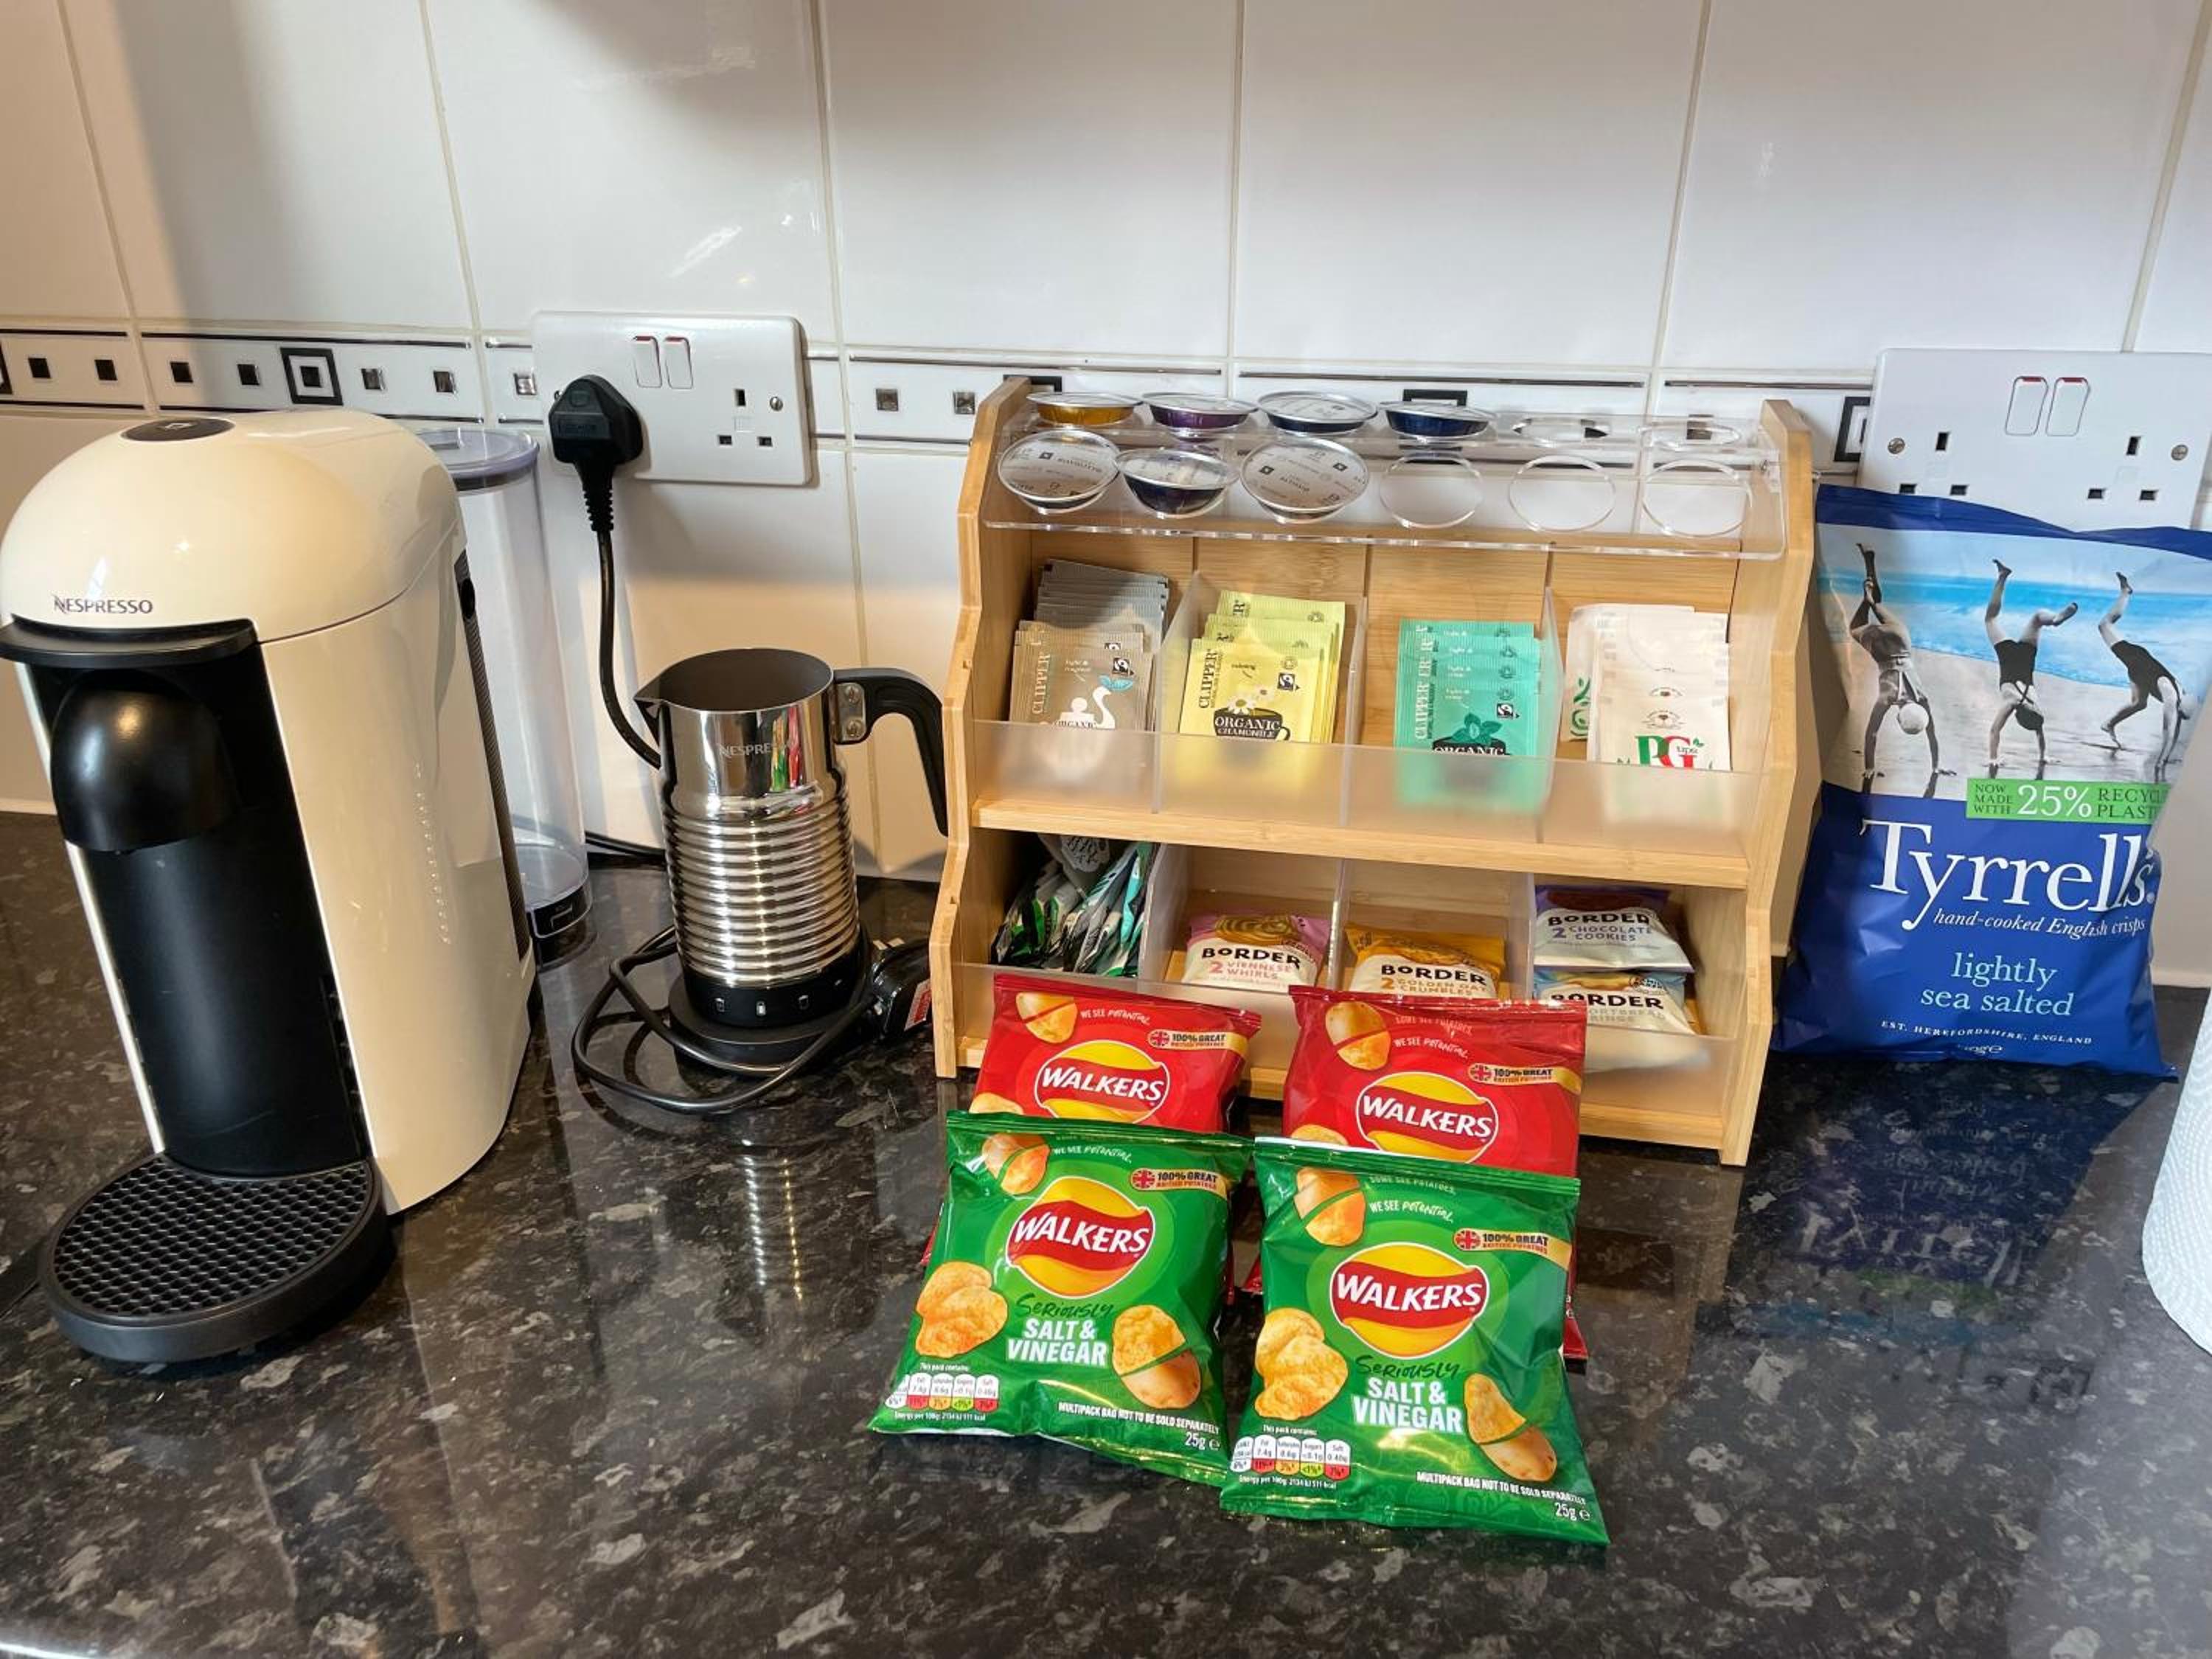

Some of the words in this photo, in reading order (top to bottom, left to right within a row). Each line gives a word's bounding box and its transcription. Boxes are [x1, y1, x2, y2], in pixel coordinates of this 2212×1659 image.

[54, 594, 153, 614] NESPRESSO
[1032, 654, 1050, 714] CLIPPER
[1199, 649, 1218, 709] CLIPPER
[1214, 715, 1281, 731] ORGANIC
[1415, 683, 1430, 740] CLIPPER
[1635, 734, 1697, 769] PG
[1974, 794, 2014, 804] MADE
[1975, 783, 2007, 795] NOW
[1973, 804, 2011, 815] WITH
[2017, 784, 2093, 818] 25%
[1551, 928, 1567, 939] 2
[1568, 925, 1652, 935] CHOCOLATE
[1933, 908, 2045, 933] hand-cooked
[2046, 917, 2109, 940] English
[2110, 916, 2146, 938] crisps
[1575, 933, 1637, 942] COOKIES
[1202, 947, 1301, 970] BORDER
[1209, 961, 1223, 974] 2
[1226, 961, 1292, 973] VIENNESE
[1226, 968, 1279, 981] WHIRLS
[1381, 964, 1488, 987] BORDER
[1381, 977, 1396, 990] 2
[1397, 978, 1455, 989] GOLDEN
[1950, 952, 2058, 992] lightly
[1400, 985, 1473, 996] CRUMBLES
[1920, 987, 1971, 1010] sea
[1980, 989, 2075, 1016] salted
[1172, 1033, 1197, 1043] 100%
[1198, 1033, 1226, 1043] GREAT
[1393, 1037, 1408, 1048] WE
[1408, 1036, 1422, 1046] SEE
[1881, 1020, 1908, 1032] EST.
[2032, 1033, 2093, 1046] ENGLAND
[1041, 1065, 1165, 1102] WALKERS
[1494, 1068, 1522, 1077] 100%
[1523, 1068, 1554, 1077] GREAT
[1362, 1095, 1494, 1138] WALKERS
[1157, 1172, 1186, 1181] 100%
[1186, 1172, 1218, 1183] GREAT
[1369, 1201, 1384, 1214] WE
[1383, 1200, 1400, 1211] SEE
[1013, 1211, 1152, 1254] WALKERS
[1482, 1233, 1514, 1243] 100%
[1515, 1234, 1549, 1246] GREAT
[1336, 1273, 1484, 1312] WALKERS
[1023, 1317, 1079, 1340] SALT
[1079, 1318, 1096, 1340] &
[1006, 1338, 1108, 1367] VINEGAR
[1367, 1376, 1426, 1405] SALT
[1427, 1380, 1446, 1405] &
[1057, 1401, 1101, 1416] MULTIPACK
[1101, 1407, 1118, 1419] BAG
[1118, 1408, 1134, 1421] NOT
[1134, 1410, 1144, 1422] TO
[1144, 1412, 1155, 1425] BE
[1155, 1414, 1176, 1427] SOLD
[1176, 1417, 1220, 1435] SEPARATELY
[1352, 1394, 1464, 1435] VINEGAR
[1184, 1432, 1206, 1451] 25g
[1416, 1471, 1464, 1487] MULTIPACK
[1464, 1478, 1481, 1489] BAG
[1481, 1479, 1499, 1492] NOT
[1499, 1481, 1509, 1493] TO
[1509, 1483, 1520, 1496] BE
[1520, 1485, 1540, 1498] SOLD
[1554, 1502, 1577, 1521] 25g
